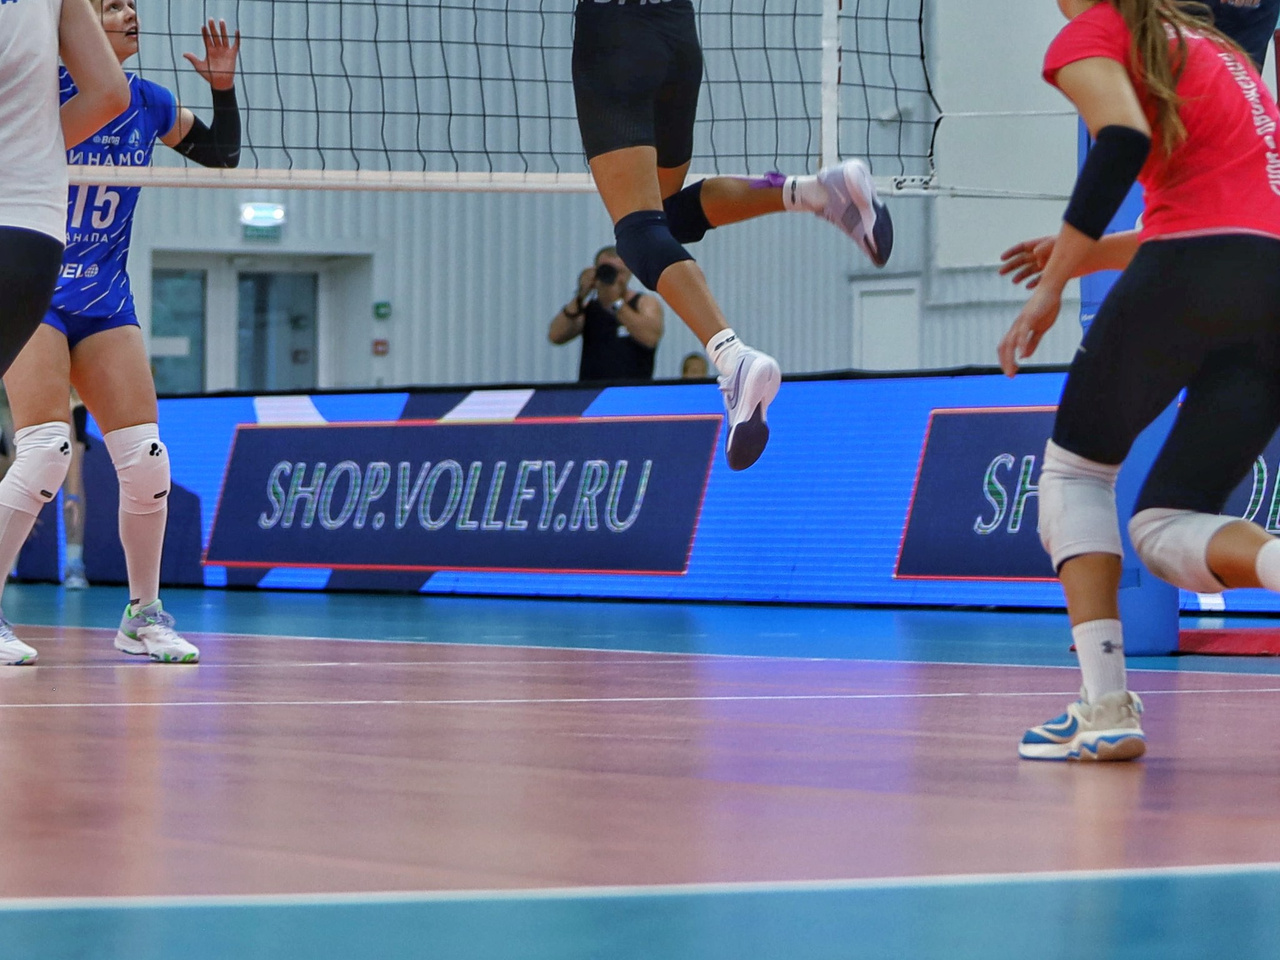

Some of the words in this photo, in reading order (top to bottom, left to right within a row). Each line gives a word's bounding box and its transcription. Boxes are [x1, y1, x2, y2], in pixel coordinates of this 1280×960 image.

[69, 149, 145, 167] ИНАМО
[71, 185, 120, 229] 15
[258, 459, 653, 532] SHOP.VOLLEY.RU
